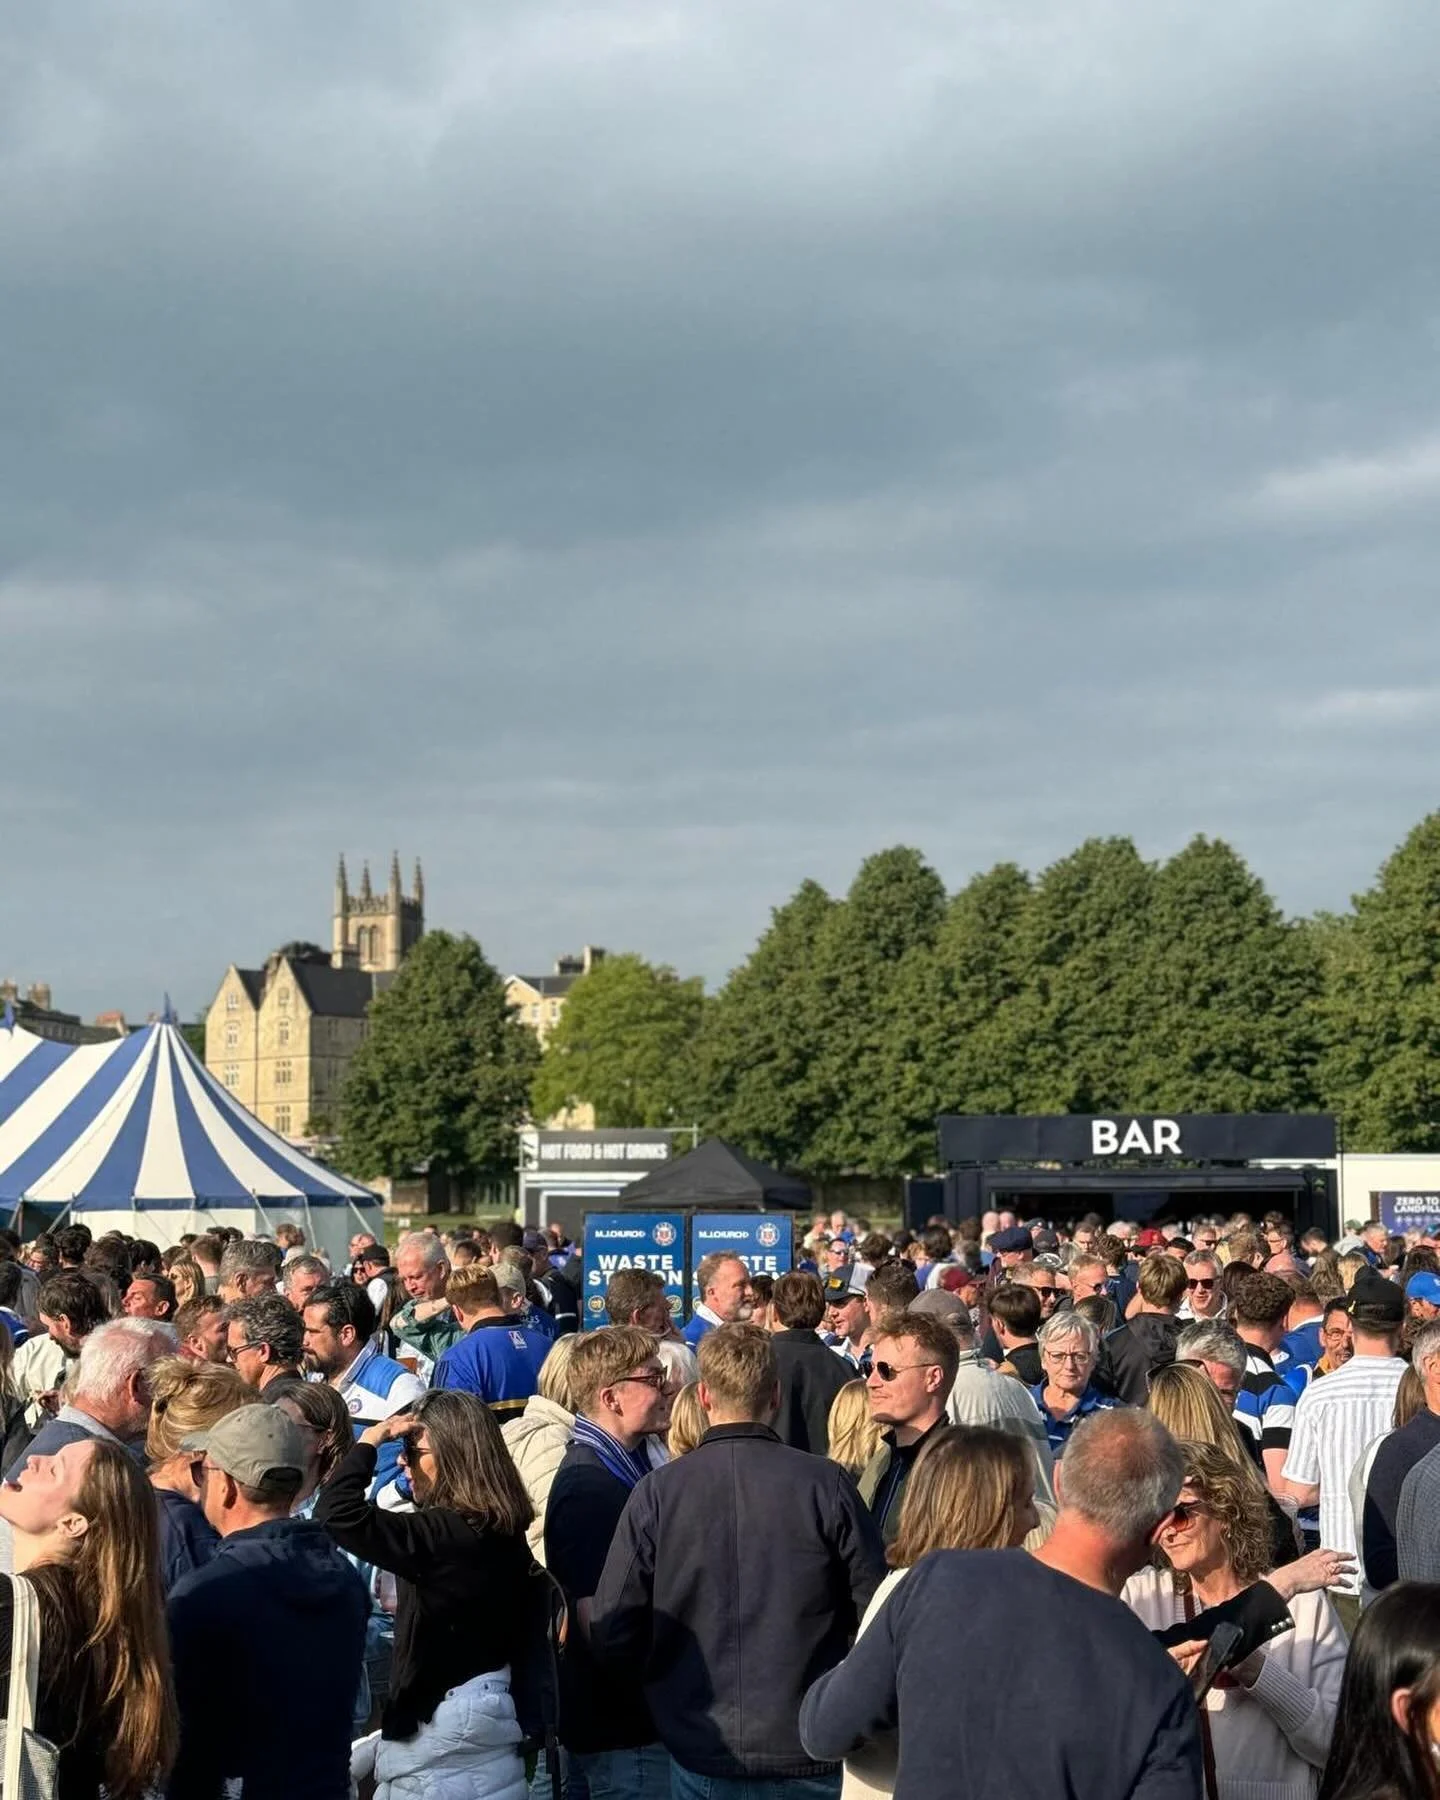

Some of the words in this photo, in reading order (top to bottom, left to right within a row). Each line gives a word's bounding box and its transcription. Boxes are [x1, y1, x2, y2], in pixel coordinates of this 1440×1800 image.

[1091, 1119, 1183, 1155] BAR
[540, 1142, 562, 1160] HOT
[564, 1142, 593, 1160] FOOD
[593, 1142, 603, 1160] &
[603, 1142, 625, 1160] HOT
[626, 1142, 668, 1160] DRINKS
[1395, 1196, 1423, 1206] ZERO
[1424, 1196, 1439, 1206] TO
[597, 1254, 673, 1270] WASTE
